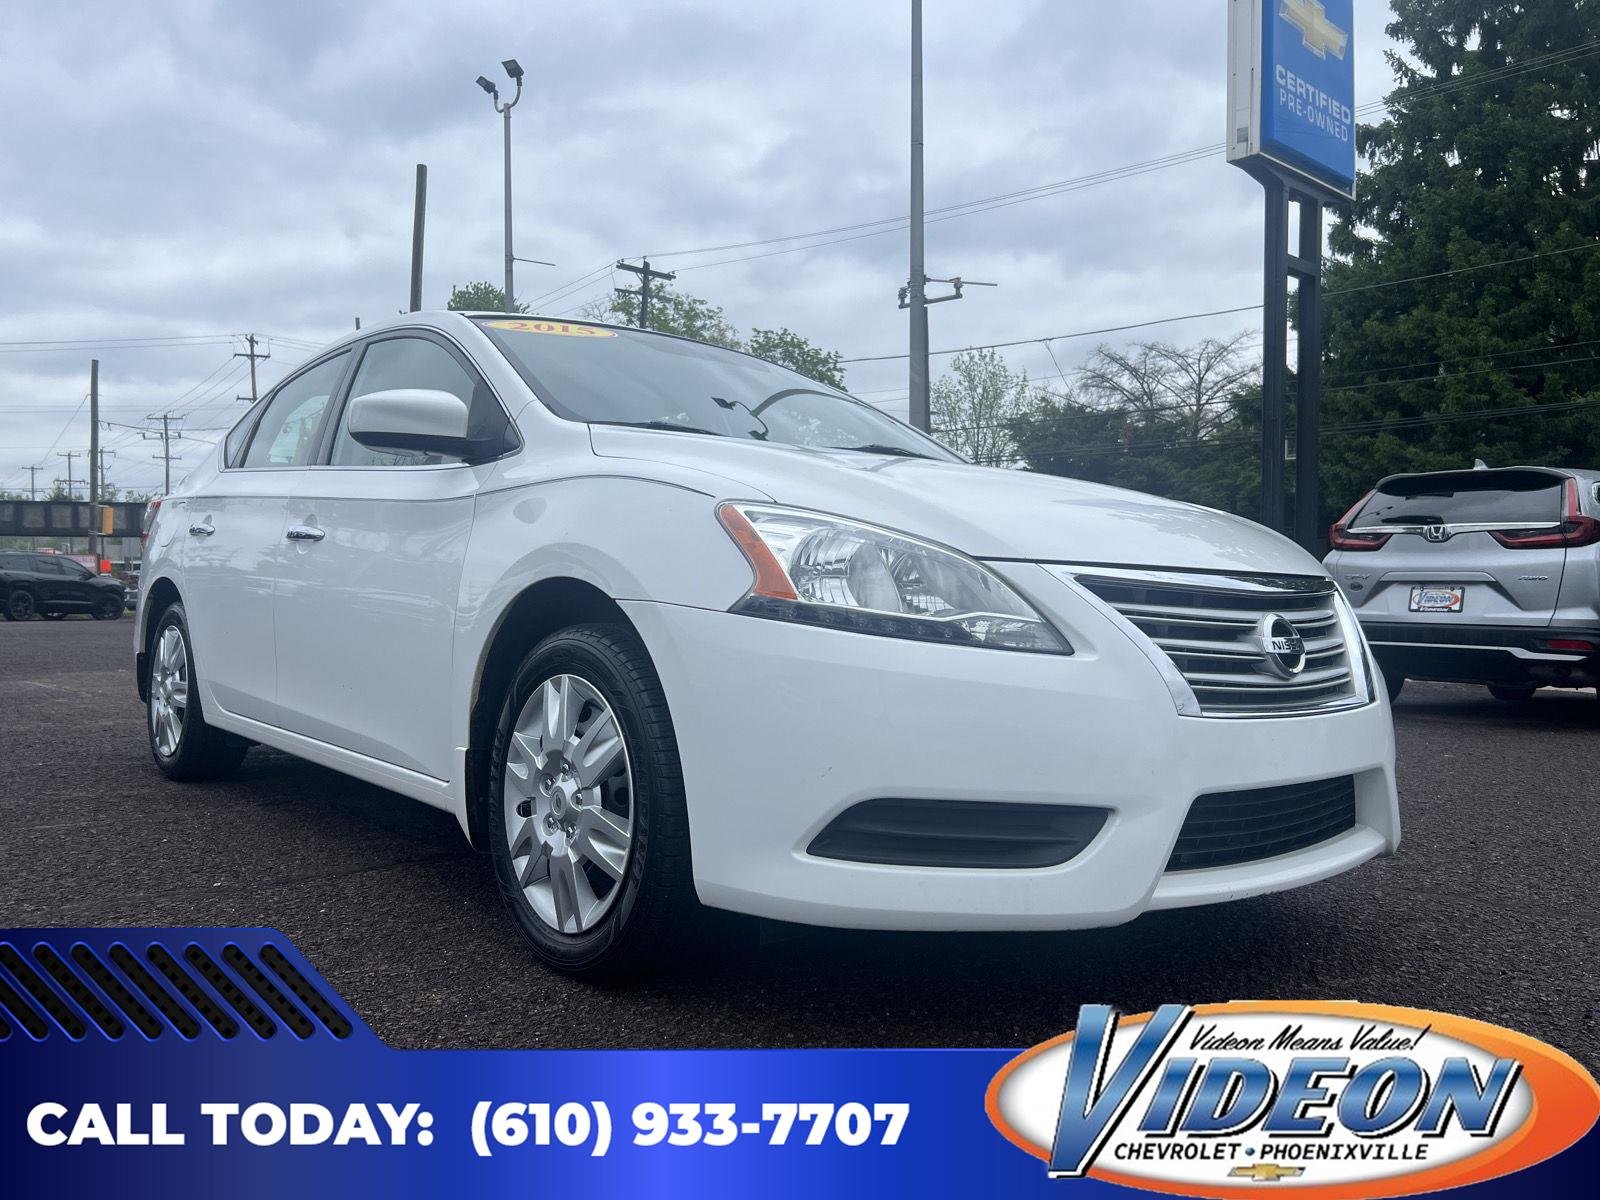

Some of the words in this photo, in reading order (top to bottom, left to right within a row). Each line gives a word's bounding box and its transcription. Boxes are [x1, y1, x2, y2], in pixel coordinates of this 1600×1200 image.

[1275, 64, 1350, 124] CERTIFIED
[1280, 89, 1348, 142] PRE-OWNED
[507, 322, 595, 335] 2015
